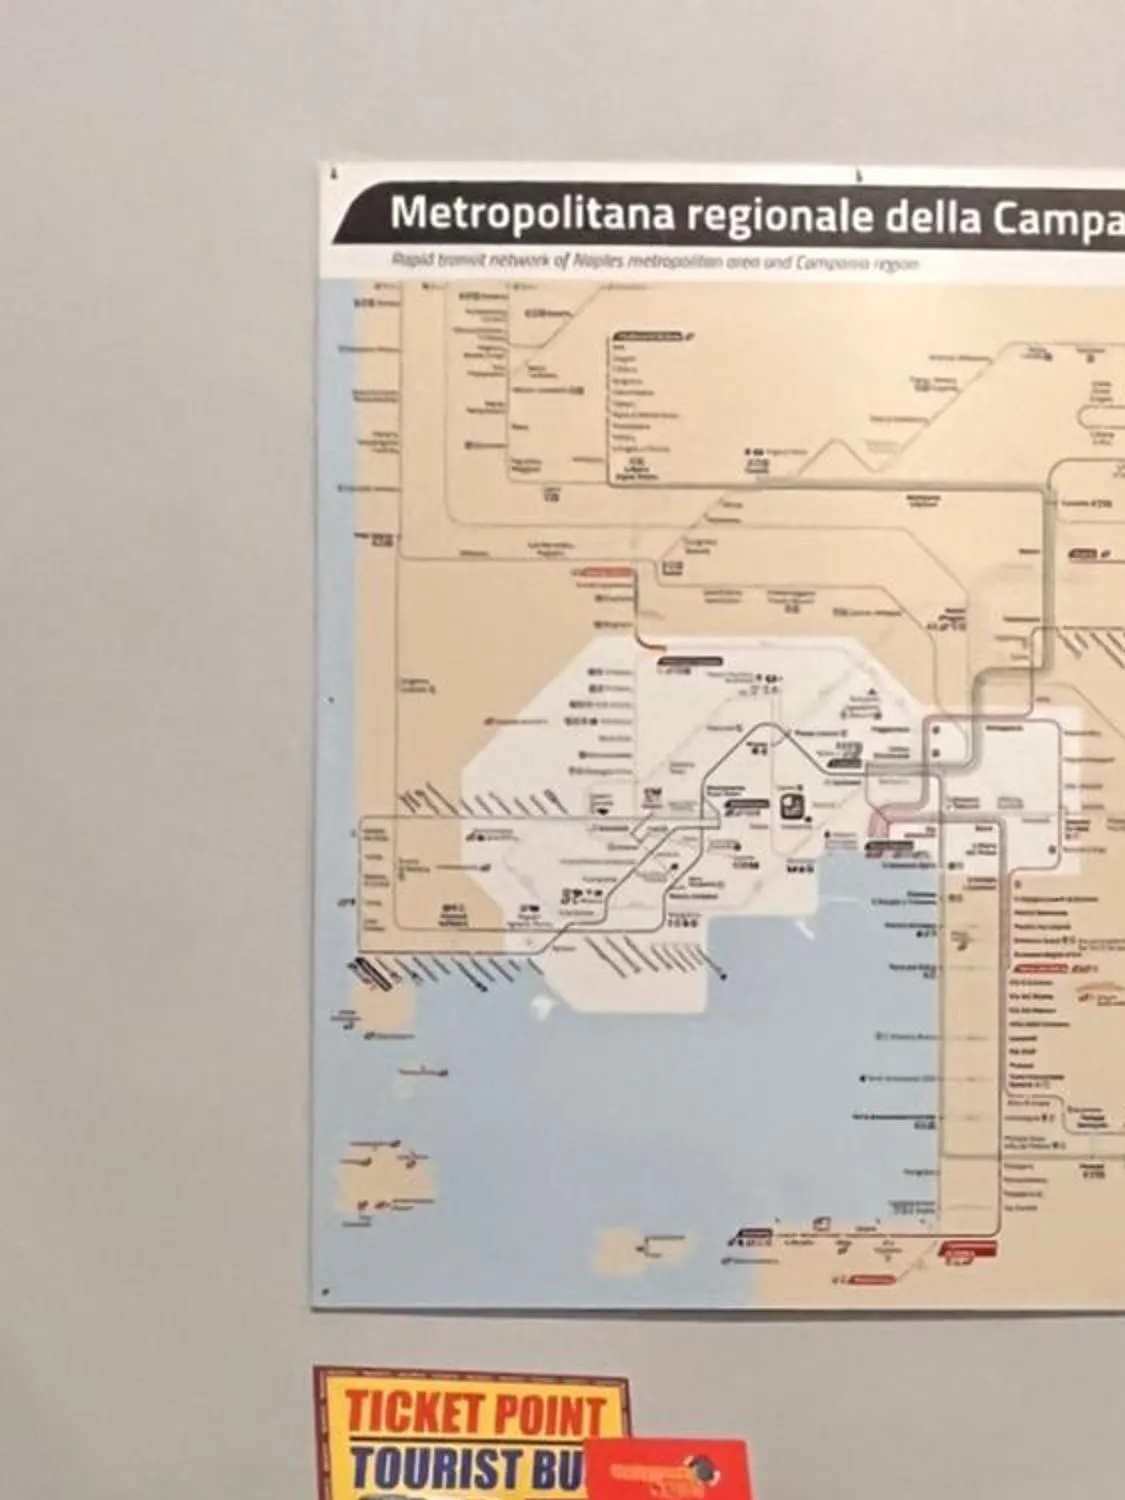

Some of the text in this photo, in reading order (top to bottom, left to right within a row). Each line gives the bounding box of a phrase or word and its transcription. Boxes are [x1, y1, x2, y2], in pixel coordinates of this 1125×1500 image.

[391, 194, 674, 238] Metropolitana
[688, 197, 873, 241] regionale
[885, 198, 981, 234] della
[392, 252, 919, 274] Rapid transit network of Naples metropolitan area and Campania region
[346, 1390, 607, 1437] TICKET POINT
[352, 1446, 523, 1490] TOURIST
[532, 1450, 584, 1491] BU
